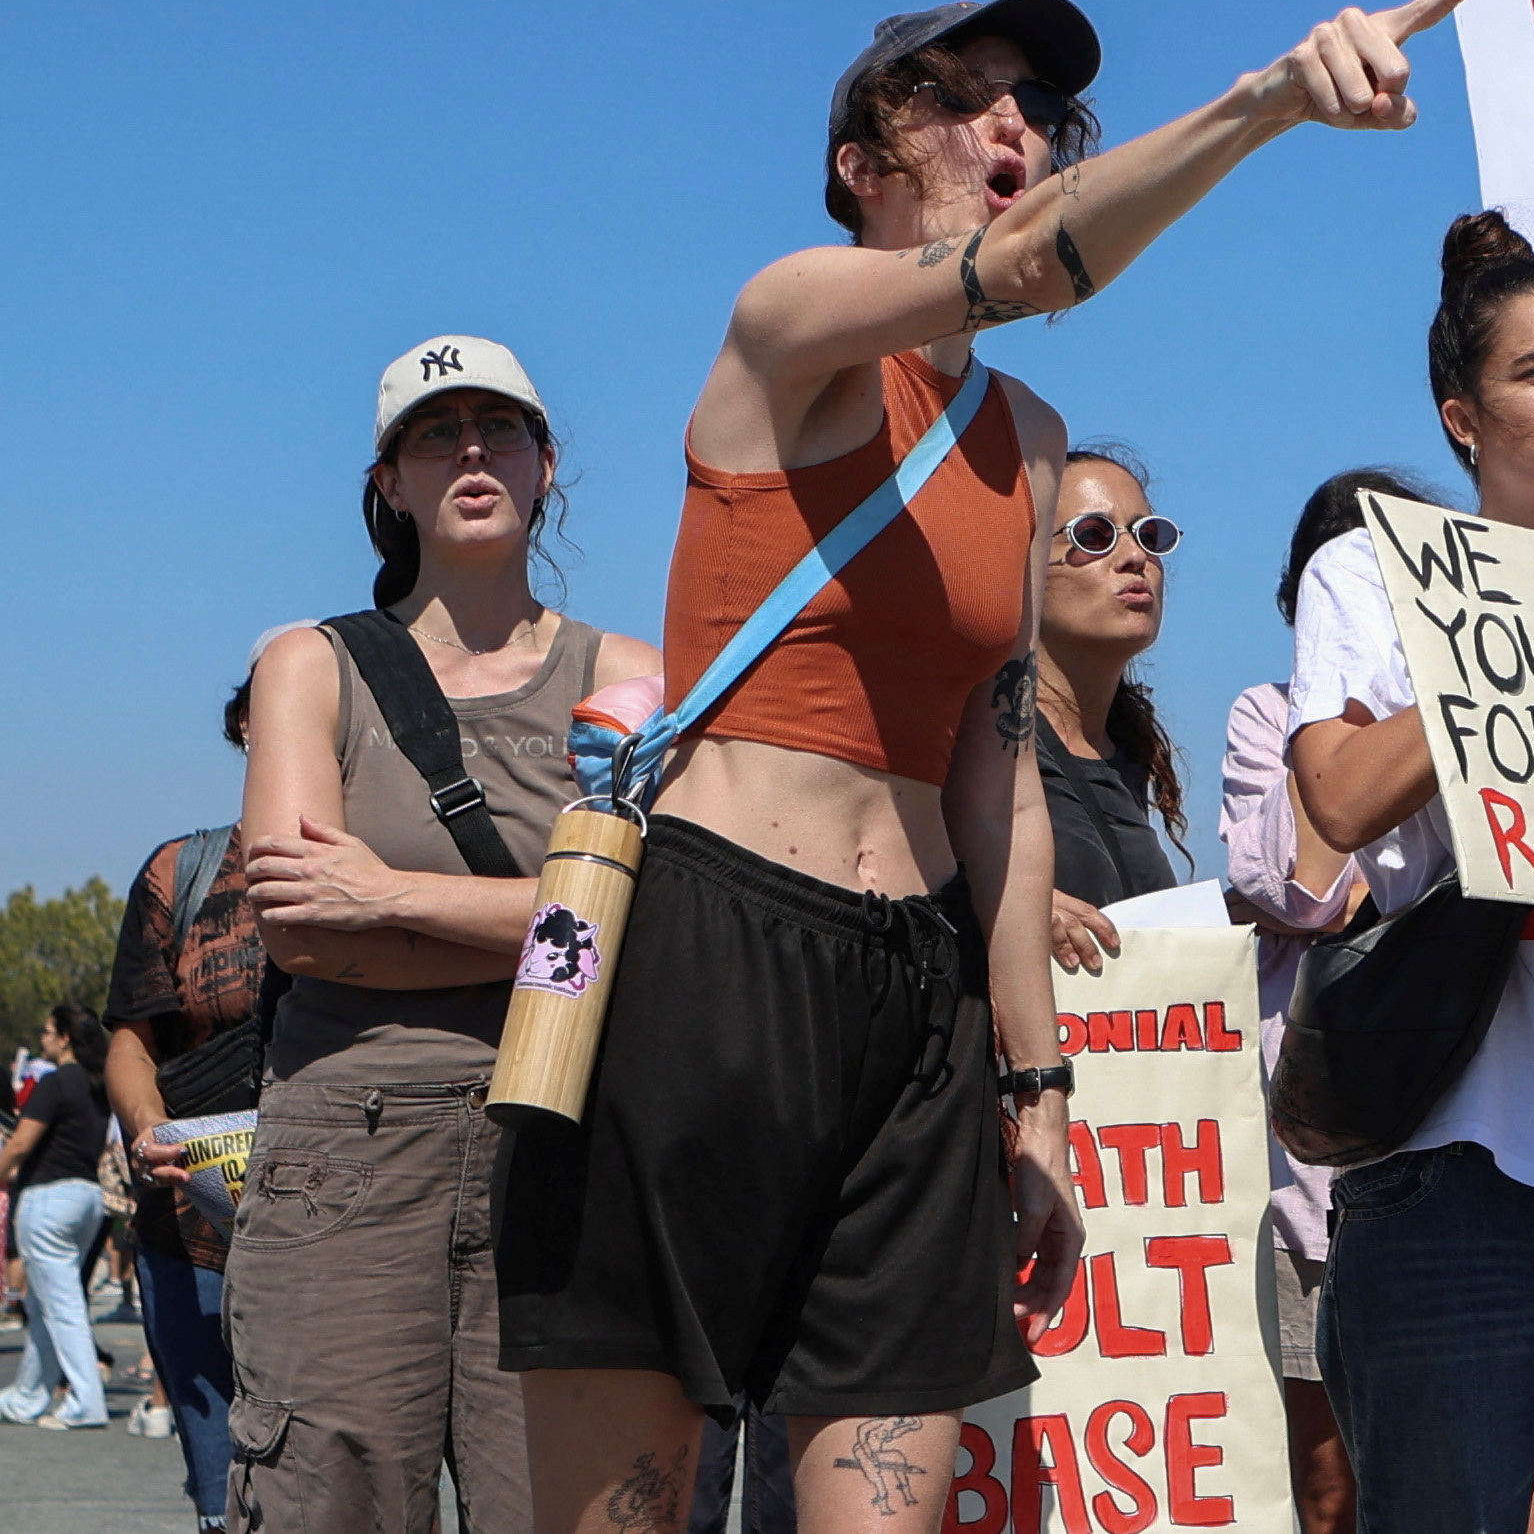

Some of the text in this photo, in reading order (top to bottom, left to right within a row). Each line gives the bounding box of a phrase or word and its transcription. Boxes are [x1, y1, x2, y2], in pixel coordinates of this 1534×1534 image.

[1369, 494, 1521, 605] WE
[1055, 1002, 1243, 1053] ONIAL
[1066, 1118, 1225, 1209] ATH
[1016, 1234, 1233, 1358] ULT
[940, 1391, 1237, 1534] BASE
